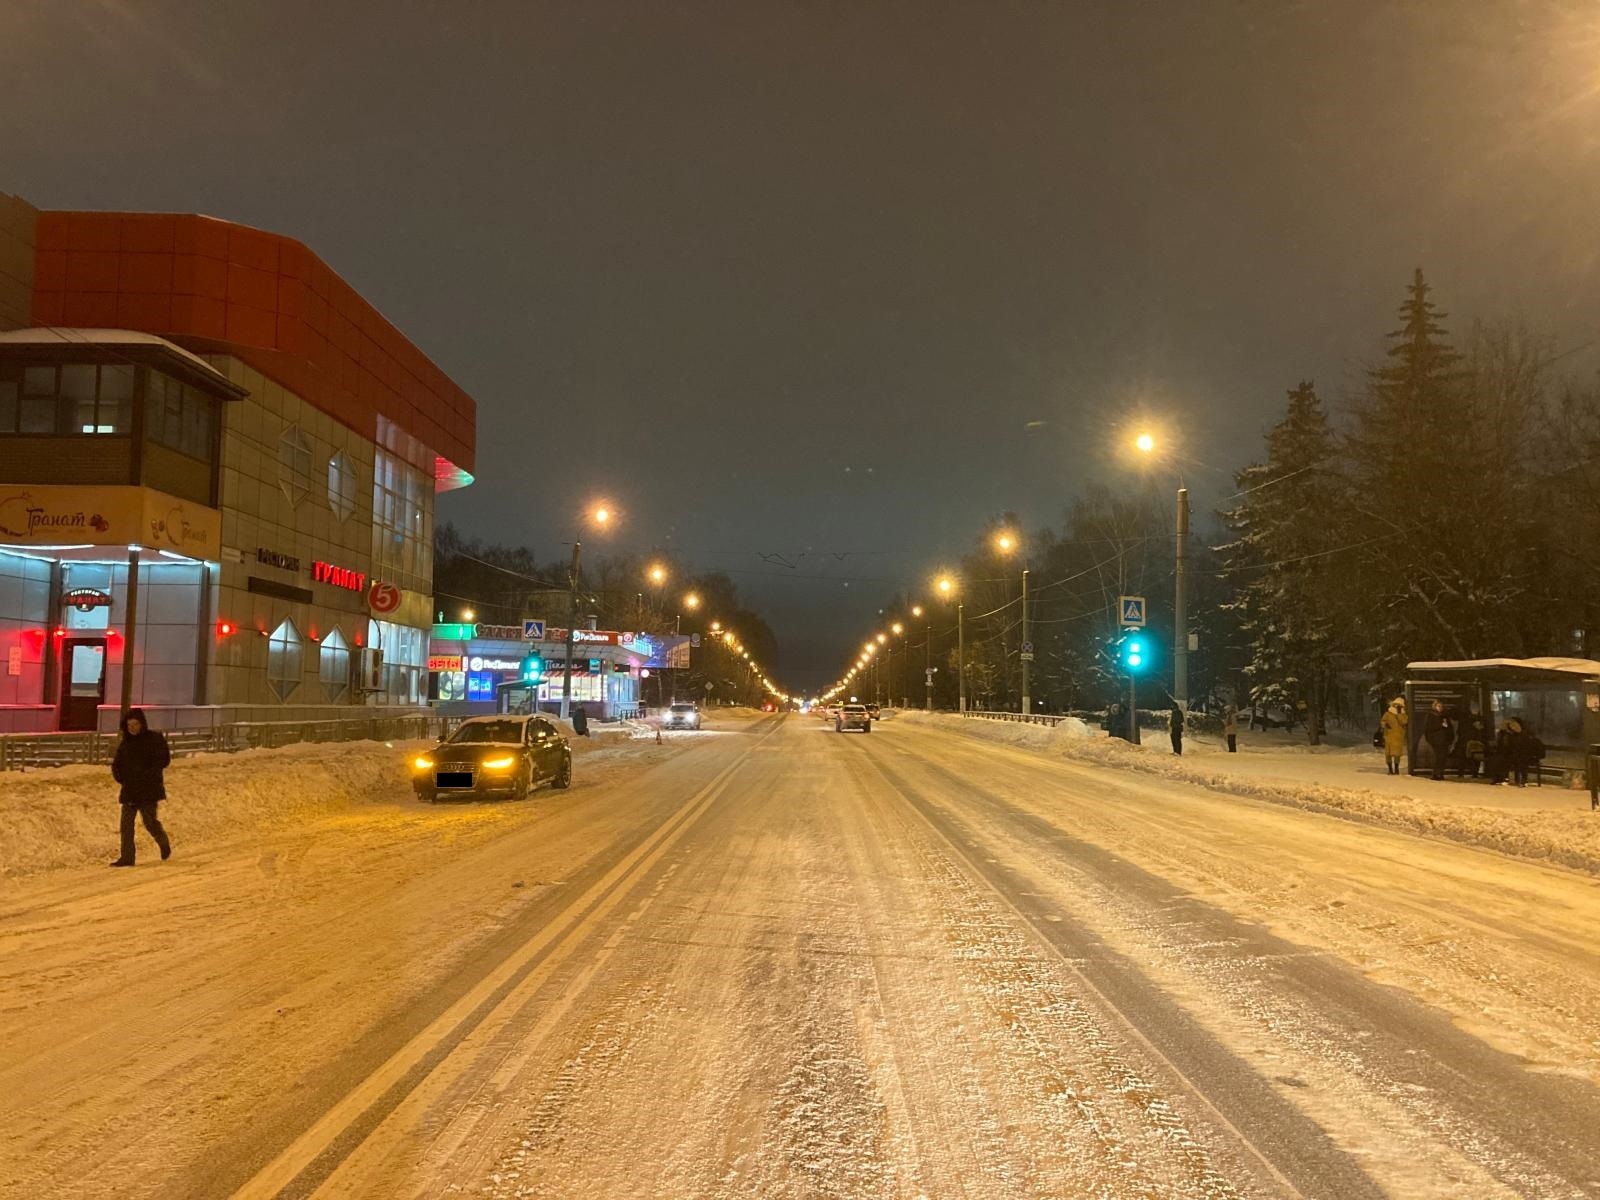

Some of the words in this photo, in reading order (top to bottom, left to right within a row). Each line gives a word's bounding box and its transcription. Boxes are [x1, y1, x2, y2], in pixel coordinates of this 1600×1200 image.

[26, 507, 86, 536] Гранат
[313, 561, 364, 592] ГРАНАТ
[428, 658, 461, 669] ВЕТЫ
